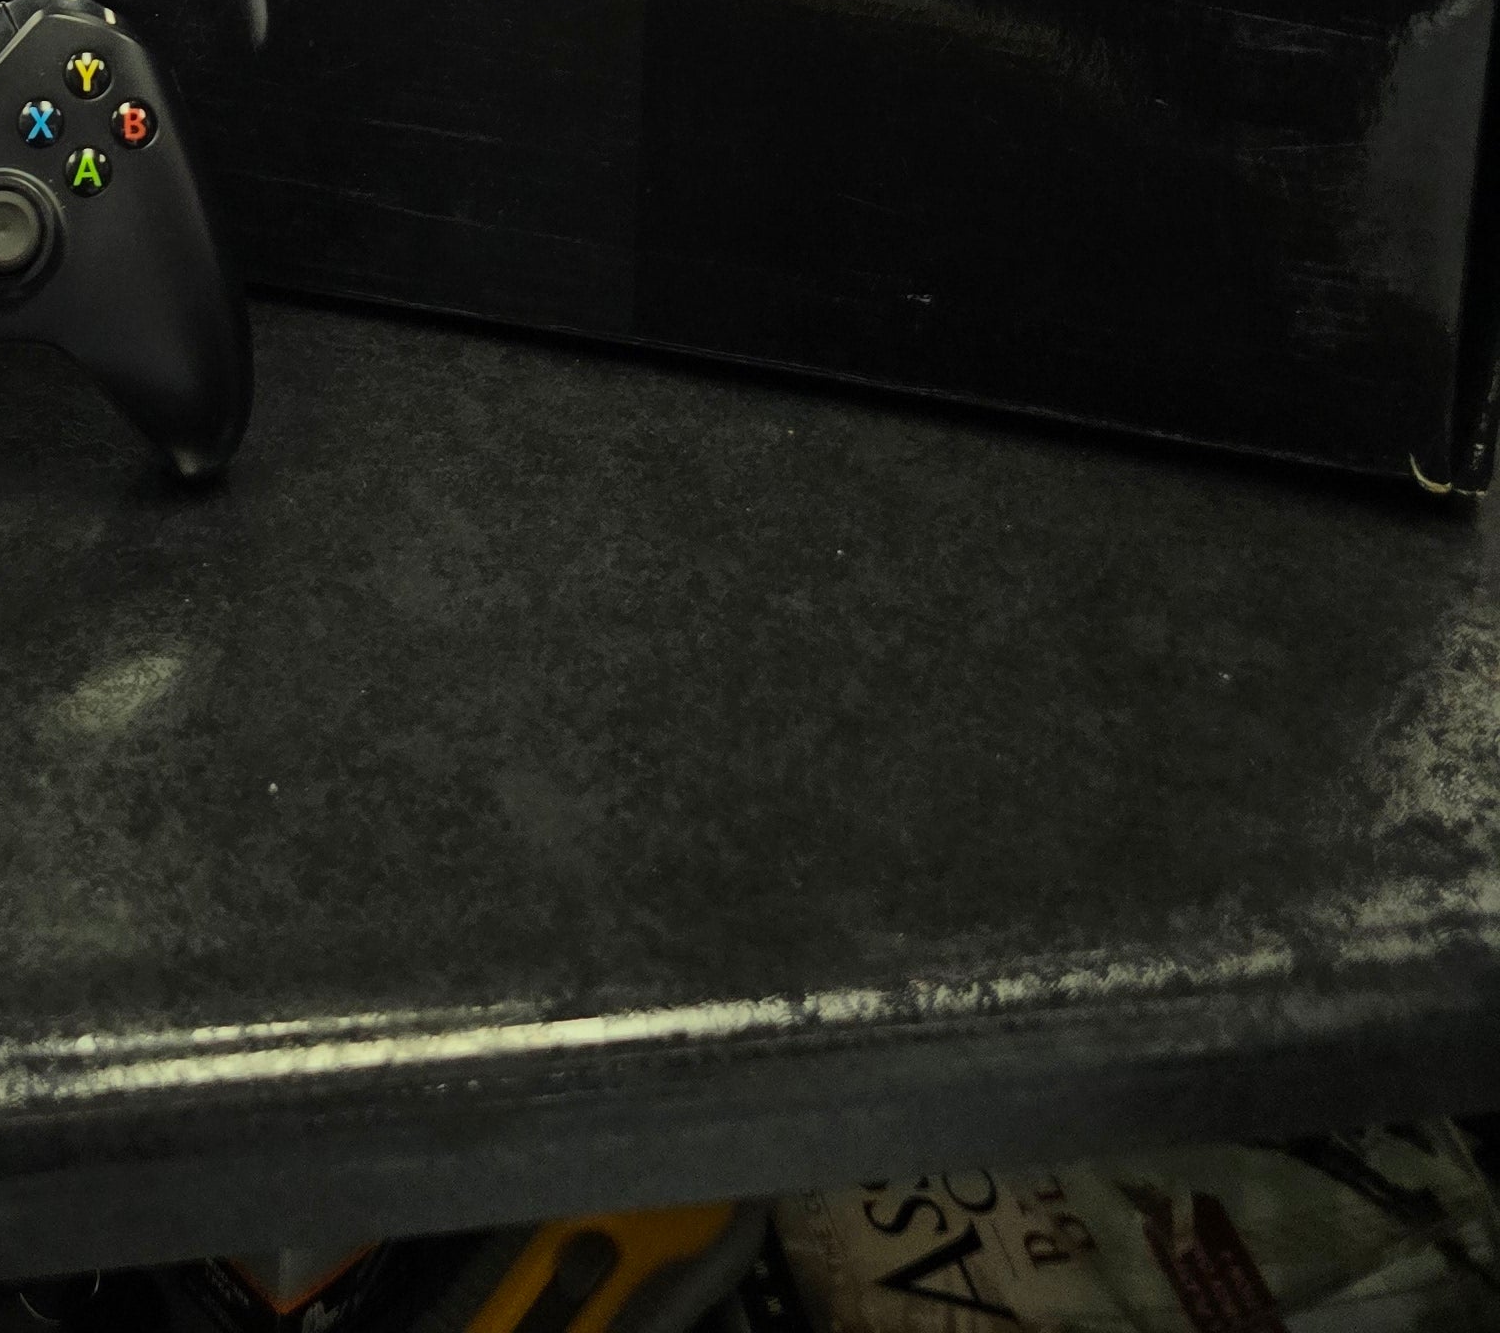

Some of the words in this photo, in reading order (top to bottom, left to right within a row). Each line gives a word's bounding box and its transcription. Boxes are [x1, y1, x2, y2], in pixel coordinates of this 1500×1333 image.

[73, 58, 102, 92] Y
[27, 107, 54, 141] X
[122, 108, 147, 140] B
[72, 154, 103, 187] A
